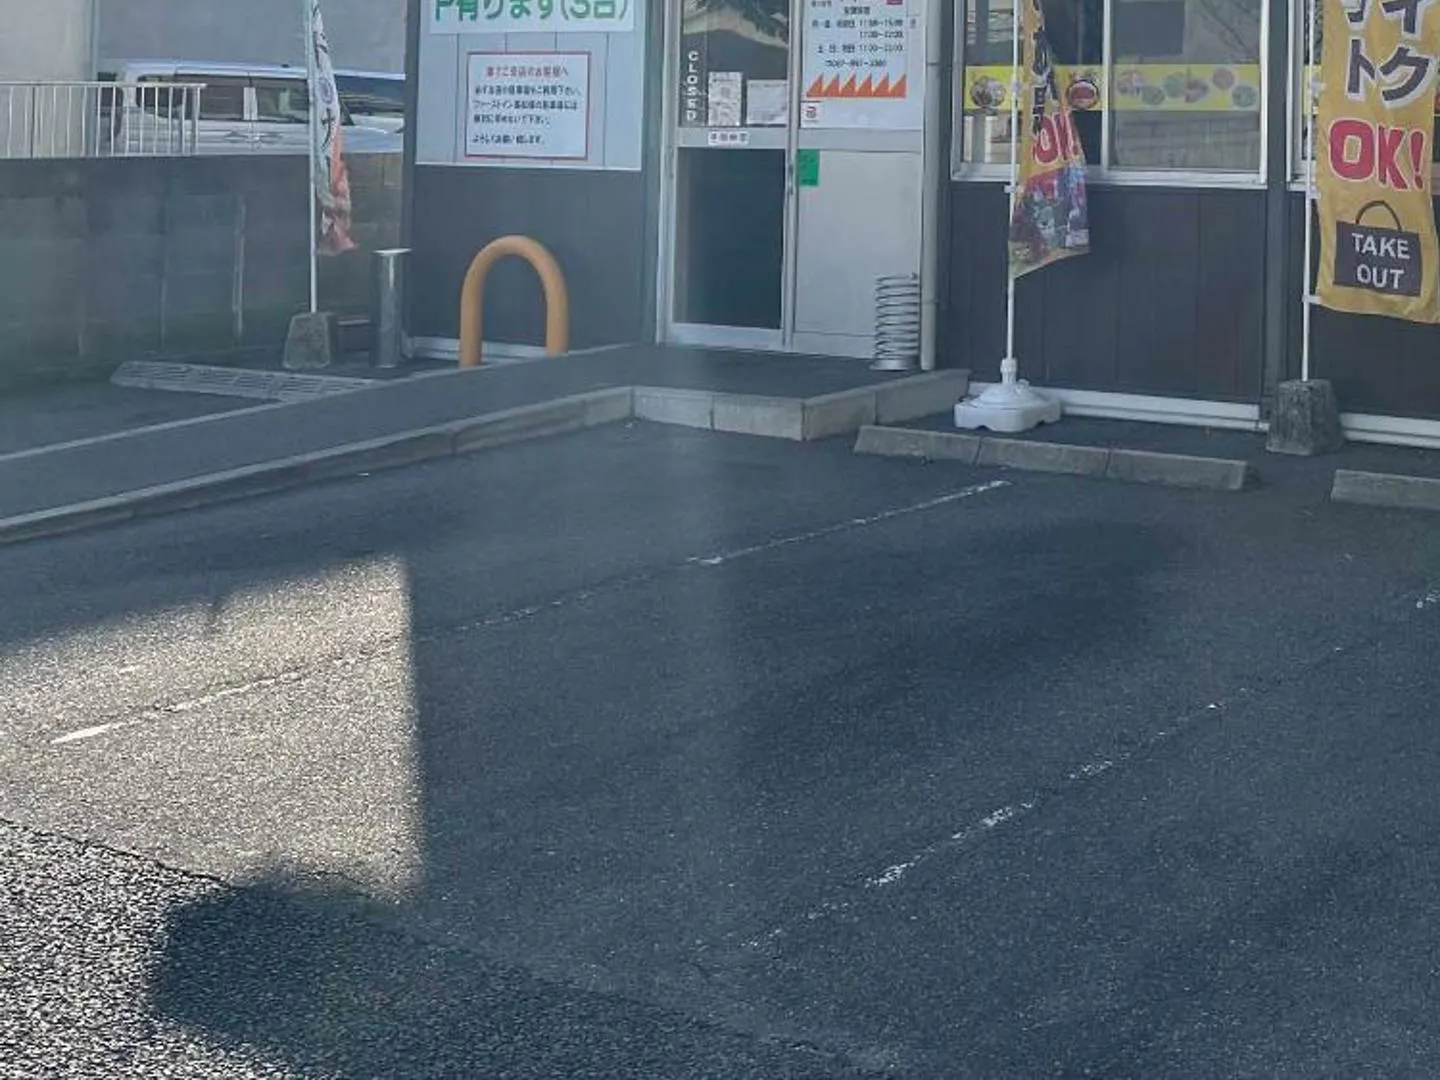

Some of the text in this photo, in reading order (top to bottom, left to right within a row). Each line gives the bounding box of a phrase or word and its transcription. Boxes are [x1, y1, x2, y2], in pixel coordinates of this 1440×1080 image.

[686, 50, 700, 121] CLOSED
[1328, 119, 1425, 191] OK!
[1351, 232, 1411, 261] TAKE
[1356, 264, 1406, 290] OUT
